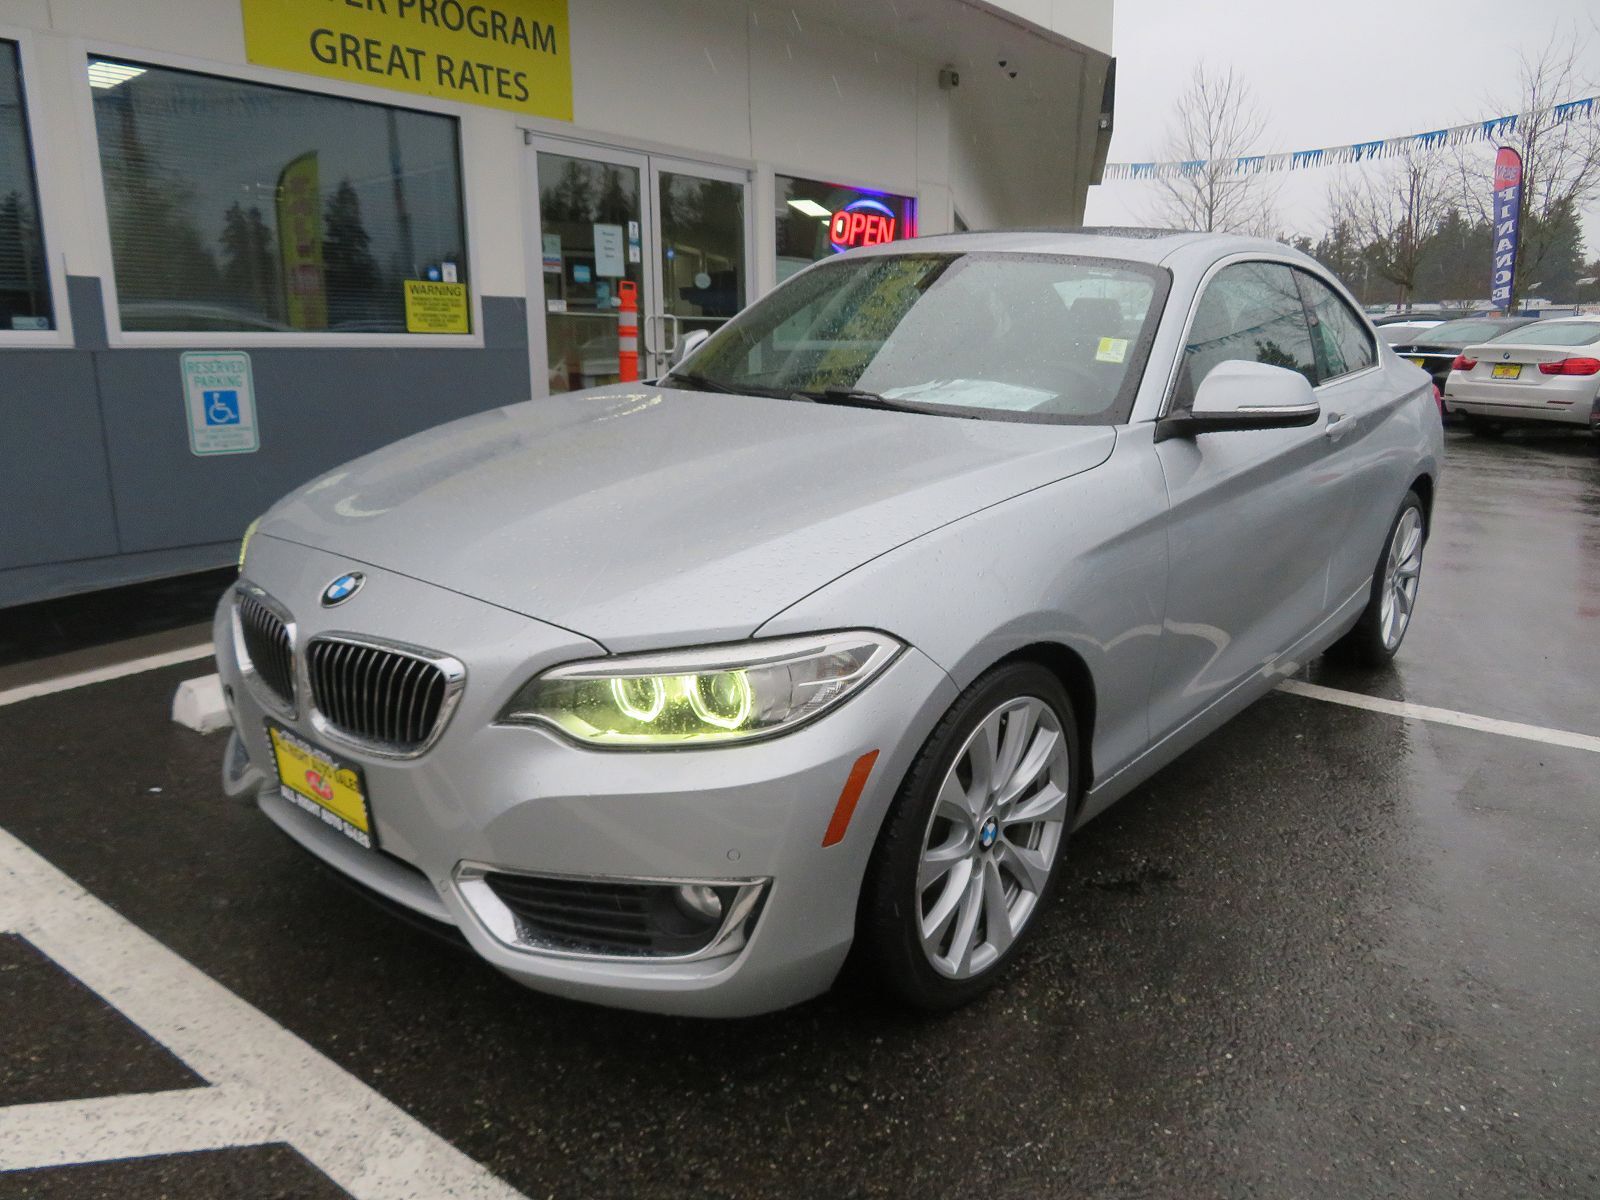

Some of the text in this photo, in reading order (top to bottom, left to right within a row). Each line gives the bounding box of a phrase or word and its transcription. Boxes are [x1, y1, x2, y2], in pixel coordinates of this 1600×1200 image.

[397, 0, 557, 55] PROGRAM
[310, 28, 529, 101] GREAT RATES
[831, 210, 896, 247] OPEN
[409, 285, 462, 297] WARNING
[186, 360, 246, 374] RESERVED
[194, 375, 242, 387] PARKING
